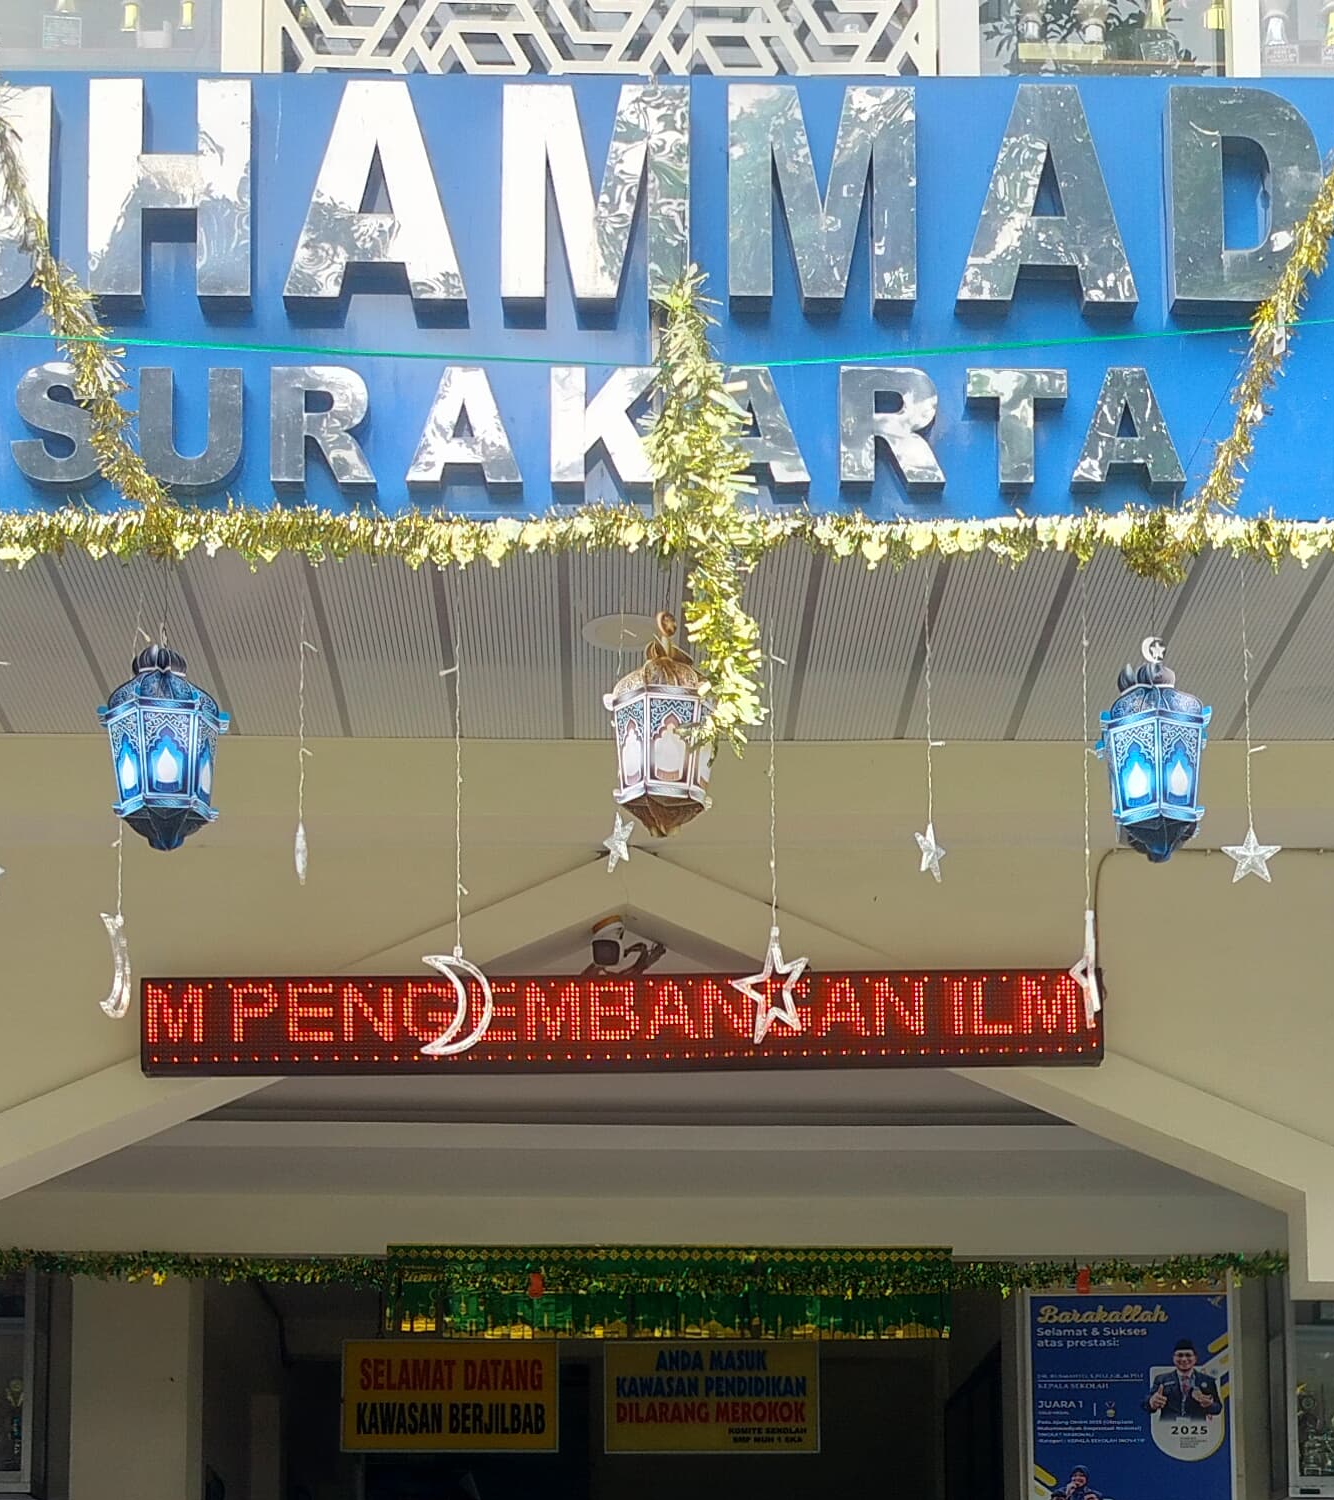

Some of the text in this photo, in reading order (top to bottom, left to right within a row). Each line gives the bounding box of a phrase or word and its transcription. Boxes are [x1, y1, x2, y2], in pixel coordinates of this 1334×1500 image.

[10, 362, 1185, 494] SURAKARTA
[145, 982, 205, 1043] M
[1036, 1304, 1168, 1324] Barakallah
[1036, 1326, 1147, 1337] Selamat & Sukses
[1036, 1337, 1120, 1349] atas prestasi:
[655, 1350, 768, 1372] ANDA MASUK
[359, 1358, 544, 1391] SELAMAT DATANG
[615, 1376, 807, 1398] KAWASAN PENDIDIKAN
[615, 1401, 806, 1424] DILARANG MEROKOK
[1037, 1400, 1083, 1409] JUARA 1
[356, 1402, 546, 1435] KAWASAN BERJILBAB
[1170, 1425, 1209, 1435] 2025
